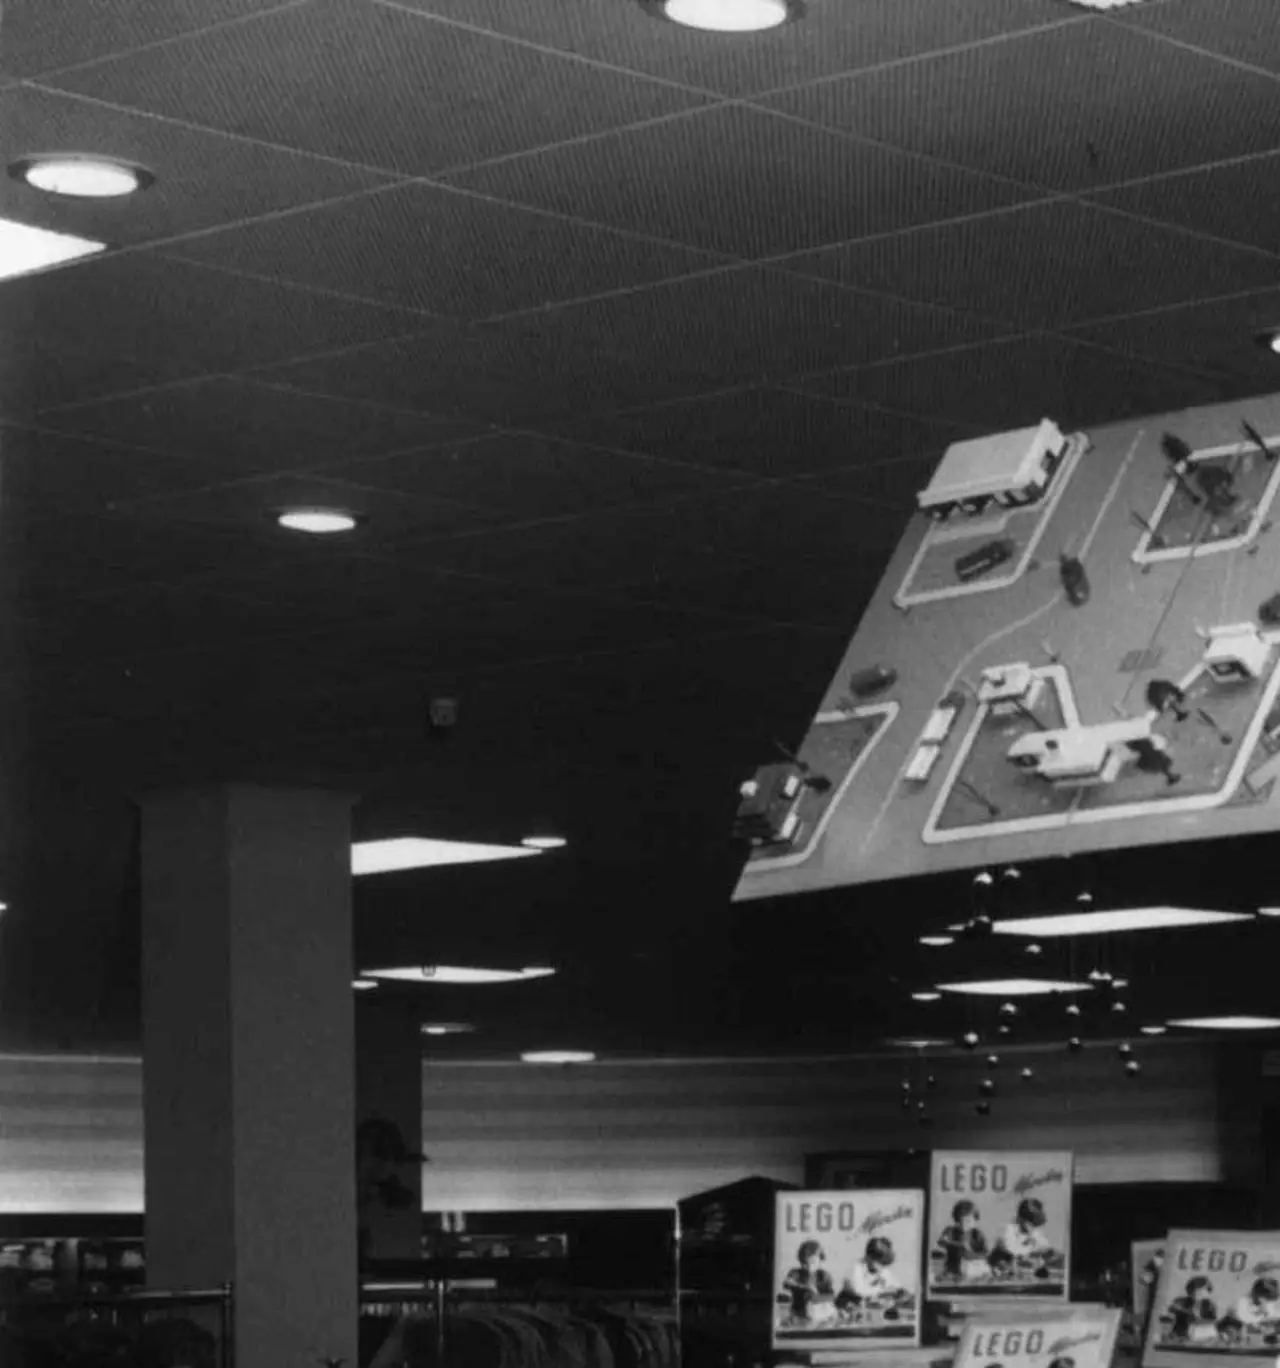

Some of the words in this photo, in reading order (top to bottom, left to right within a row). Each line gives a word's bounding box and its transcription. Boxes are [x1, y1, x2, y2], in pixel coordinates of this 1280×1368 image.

[940, 1163, 1008, 1194] LEGO
[785, 1201, 856, 1233] LEGO
[1177, 1247, 1248, 1274] LEGO
[972, 1329, 1045, 1358] LEGO
